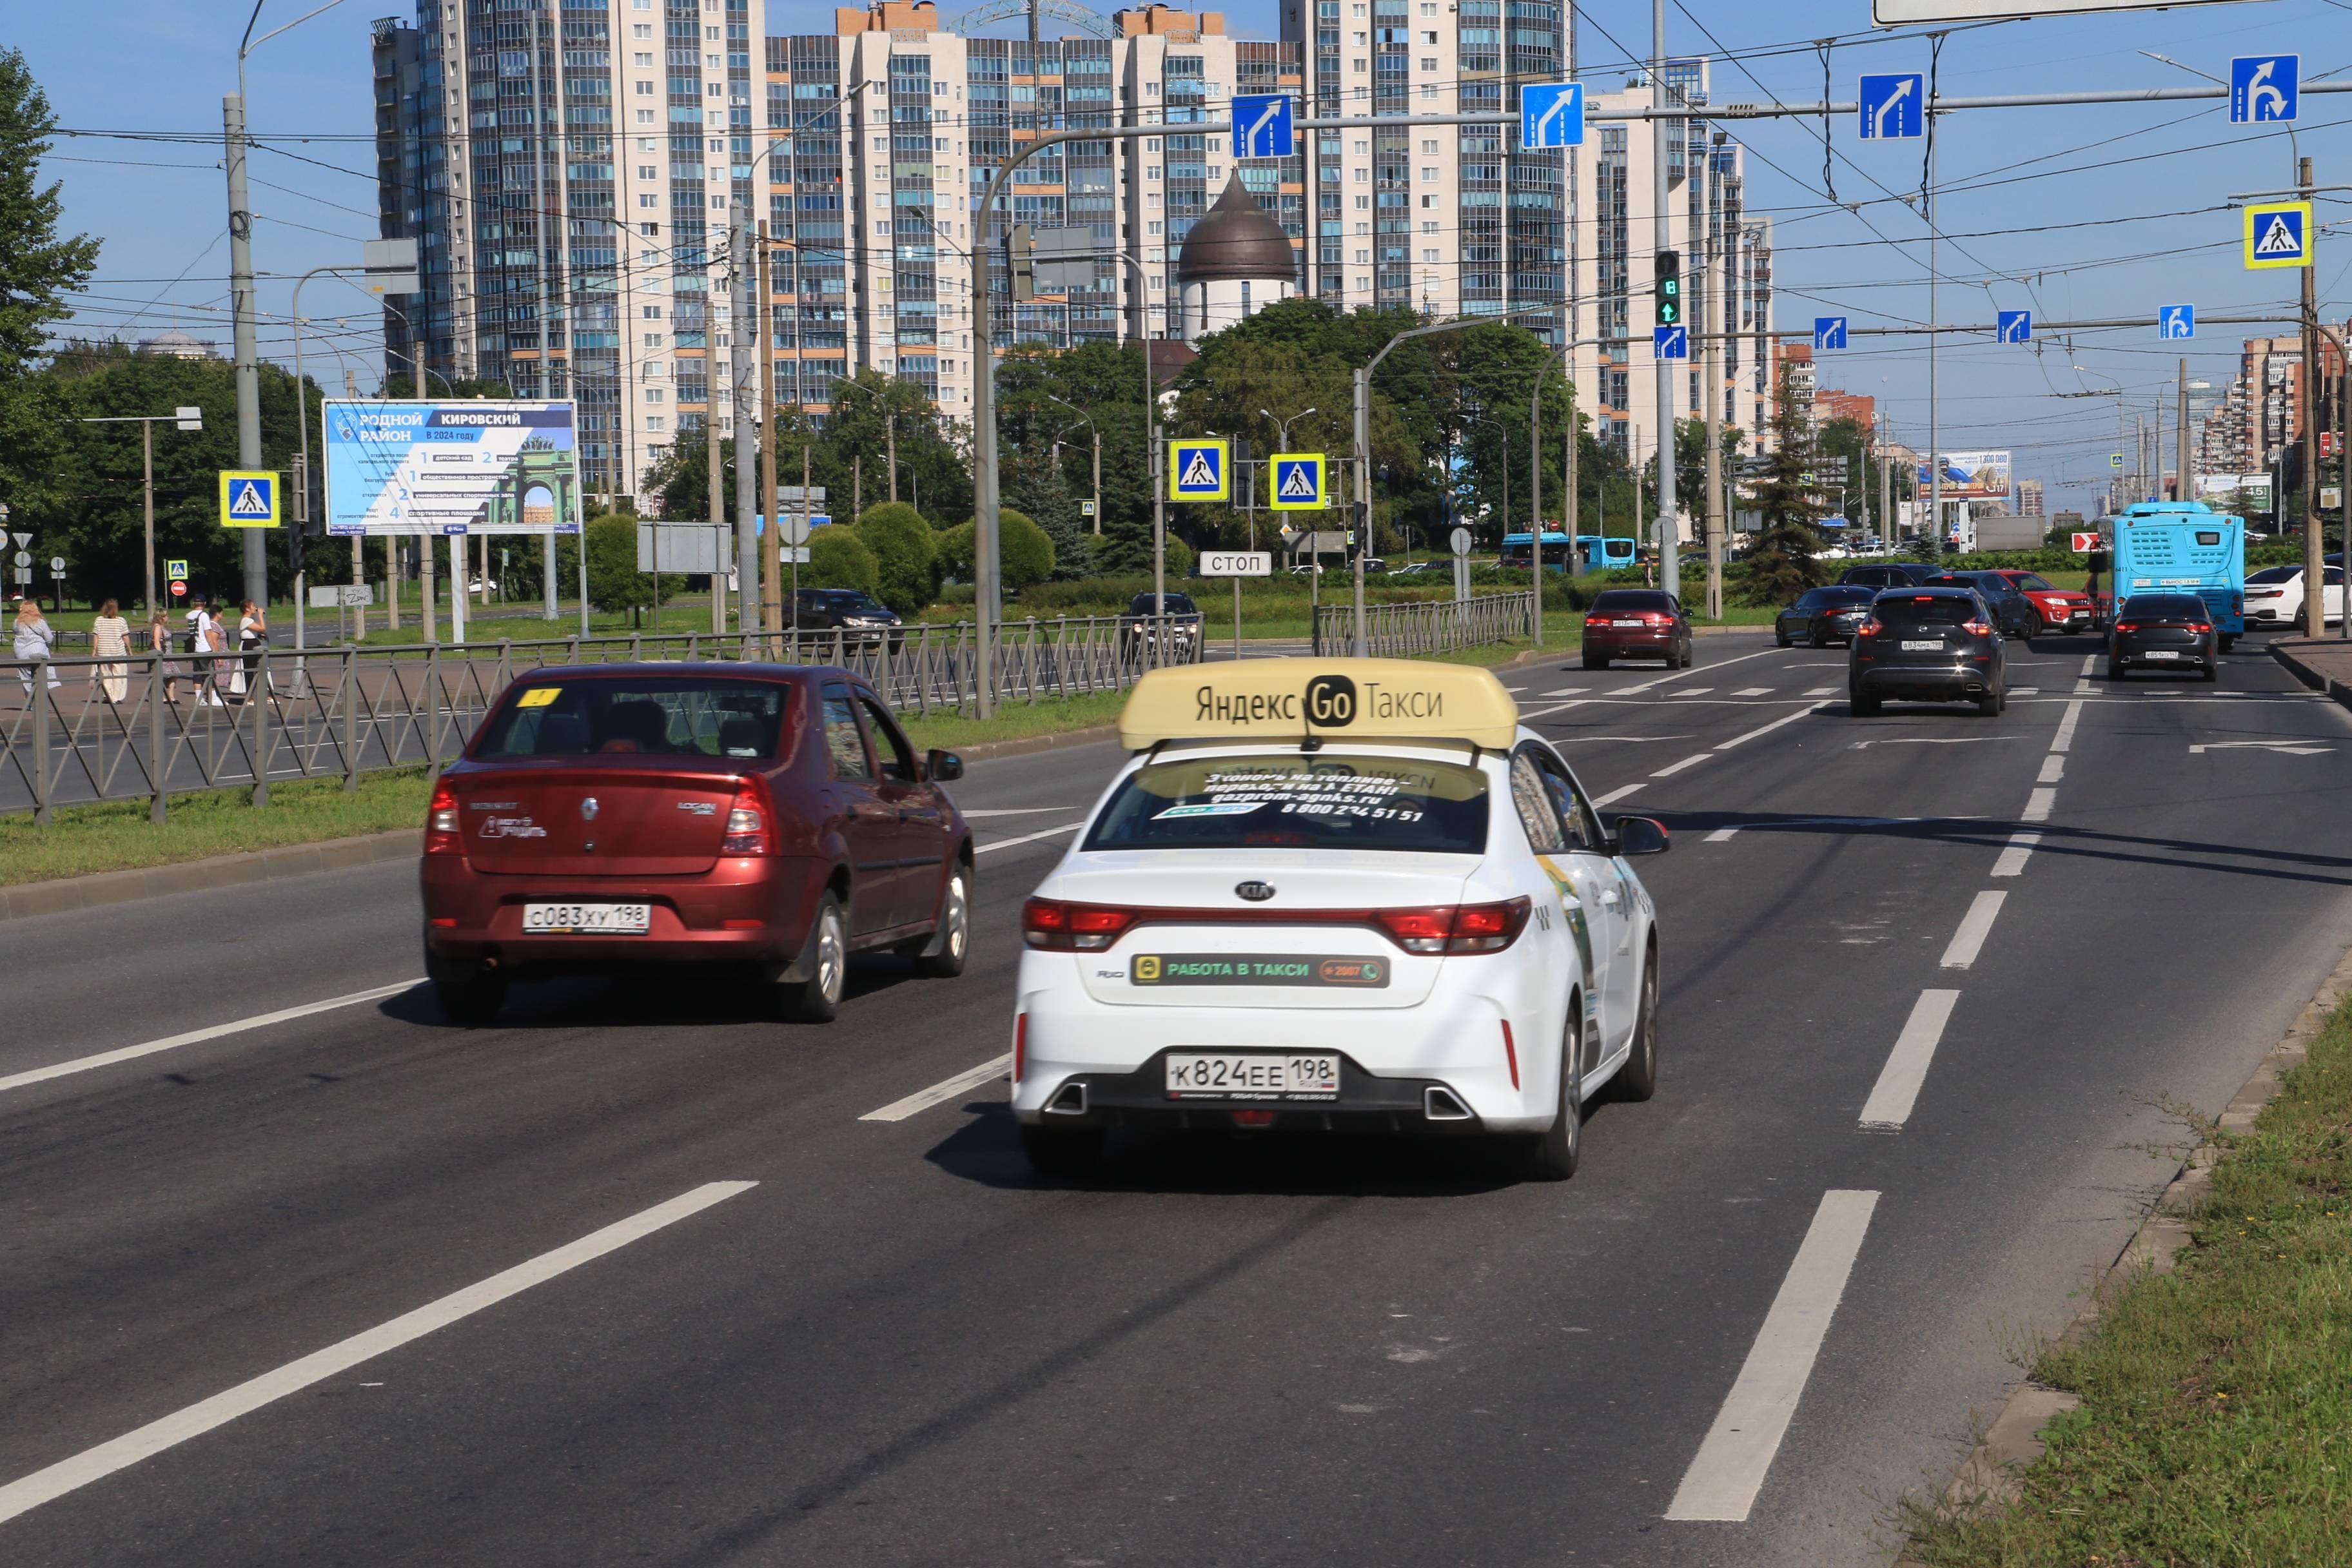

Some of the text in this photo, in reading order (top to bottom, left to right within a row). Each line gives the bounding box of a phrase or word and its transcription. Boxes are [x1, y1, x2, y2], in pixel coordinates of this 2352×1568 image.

[1665, 280, 1675, 294] 8
[359, 412, 423, 427] РОДНОЙ
[441, 413, 521, 425] КИРОВСКИЙ
[360, 428, 412, 442] РАЙОН
[456, 433, 474, 441] году
[421, 452, 427, 464] 1
[483, 452, 491, 464] 2
[410, 470, 416, 482] 1
[399, 488, 409, 500] 2
[389, 507, 400, 519] 4
[1212, 556, 1259, 571] СТОП
[1196, 683, 1443, 725] Яндекс Go Такси
[1317, 774, 1396, 785] топливе
[1211, 792, 1383, 805] gazprom-agnks.ru
[1280, 803, 1297, 814] 8
[1297, 803, 1334, 814] 800
[1371, 808, 1398, 818] 51
[1398, 810, 1424, 822] 51
[1239, 884, 1271, 897] KIA
[531, 906, 643, 926] С083ХУ 198
[1167, 963, 1309, 976] РАБОТА В ТАКСИ
[1175, 1059, 1329, 1086] К824ЕЕ 198
